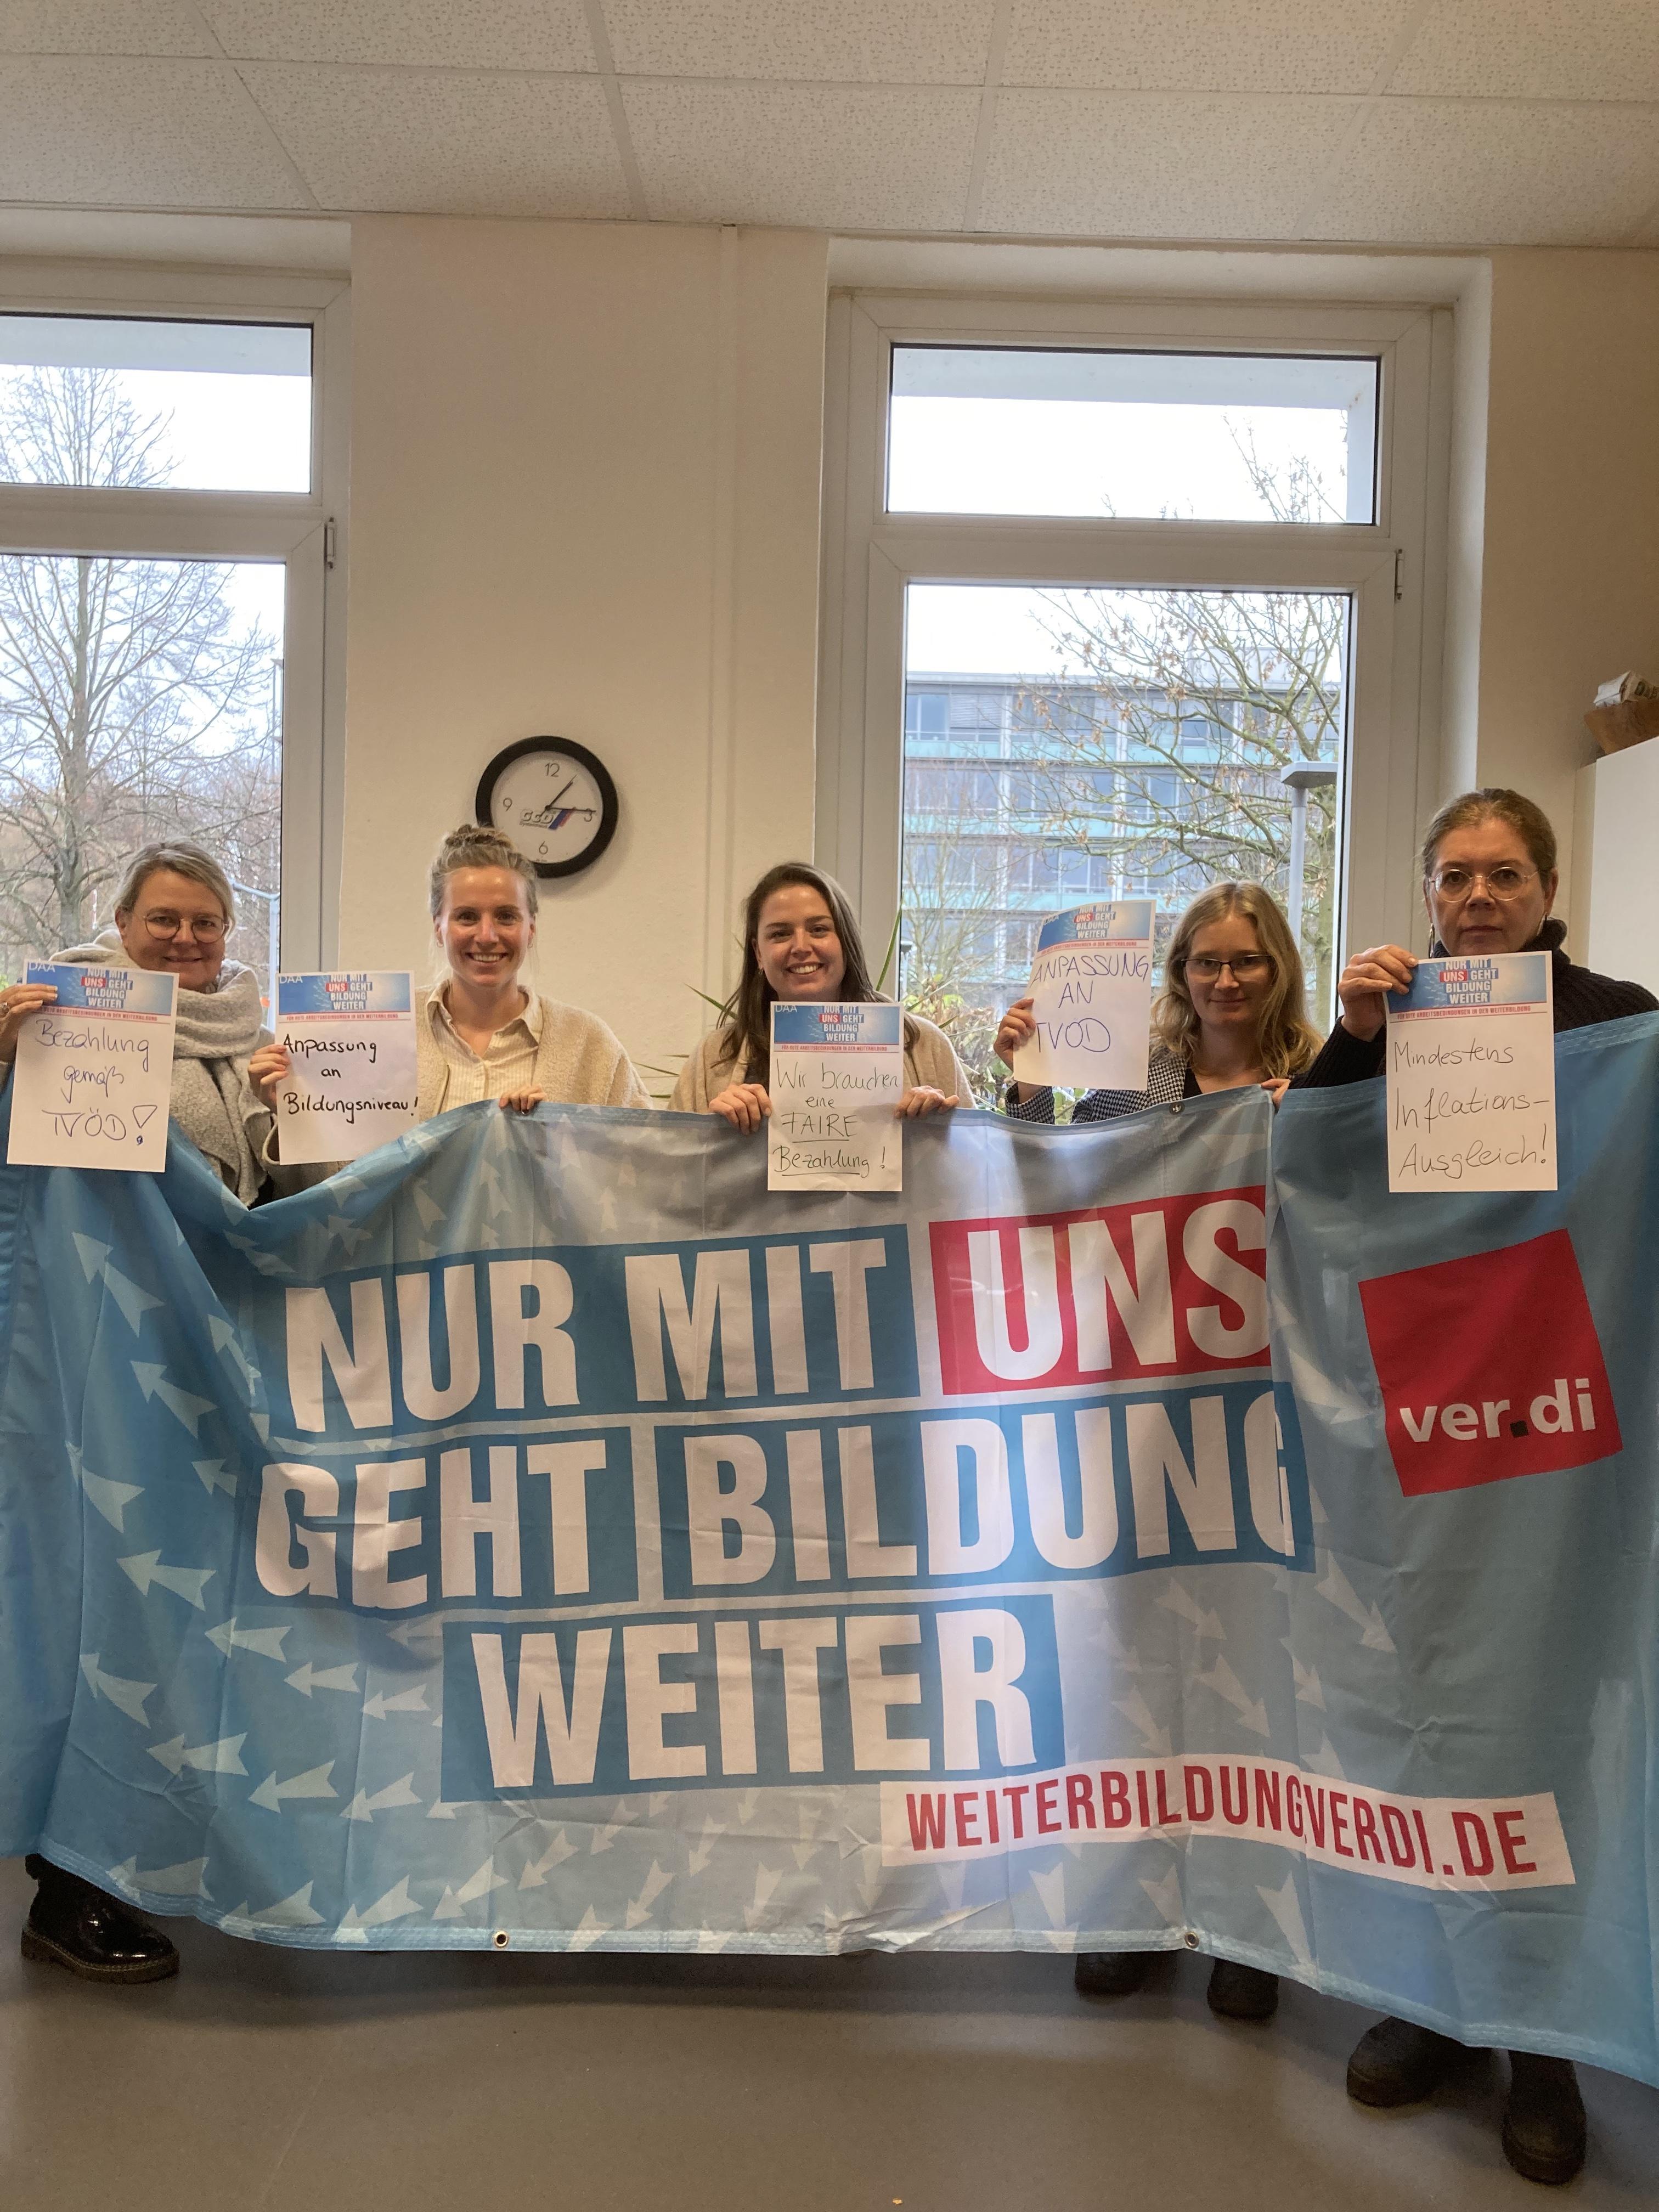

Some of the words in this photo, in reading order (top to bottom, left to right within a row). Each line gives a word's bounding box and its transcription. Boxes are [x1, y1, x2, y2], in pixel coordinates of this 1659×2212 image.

[545, 763, 560, 777] 12
[503, 798, 512, 811] 9
[539, 841, 548, 855] 6
[1076, 913, 1091, 922] UNS
[1076, 922, 1109, 930] BILDUNG
[1077, 930, 1106, 939] WEITER
[28, 962, 55, 973] DAA
[1030, 952, 1149, 988] ANPASSUNG
[1446, 961, 1466, 970] NUR
[1470, 960, 1488, 968] MIT
[87, 968, 106, 978] NUR
[110, 970, 126, 979] MIT
[1443, 972, 1464, 981] UNS
[1471, 969, 1497, 980] GEHT
[84, 978, 104, 987] UNS
[109, 980, 131, 990] GEHT
[329, 983, 346, 991] UNS
[350, 983, 371, 991] GEHT
[1446, 981, 1491, 993] BILDUNG
[86, 989, 125, 999] BILDUNG
[330, 992, 366, 1001] BILDUNG
[1058, 980, 1093, 1008] AN
[1449, 992, 1488, 1004] WEITER
[88, 998, 122, 1008] WEITER
[333, 1001, 364, 1010] WEITER
[35, 1019, 149, 1072] Bezahlung
[284, 1034, 376, 1063] Anpassung
[1395, 1038, 1513, 1073] Mindestens
[321, 1068, 341, 1078] an
[777, 1058, 807, 1089] Wir
[822, 1062, 898, 1091] brauchen
[805, 1096, 834, 1108] eine
[1396, 1087, 1549, 1133] Inflations-
[781, 1112, 857, 1137] FAIRE
[1399, 1124, 1546, 1179] Ausgleich!
[285, 1258, 580, 1432] NUR
[625, 1238, 886, 1402] MIT
[967, 1200, 1271, 1380] UNS
[1400, 1378, 1596, 1443] ver.di
[254, 1440, 607, 1610] GEHT
[471, 1609, 1036, 1788] WEITER
[906, 1765, 1538, 1877] WEITERBILDUNGVERDI.DE
